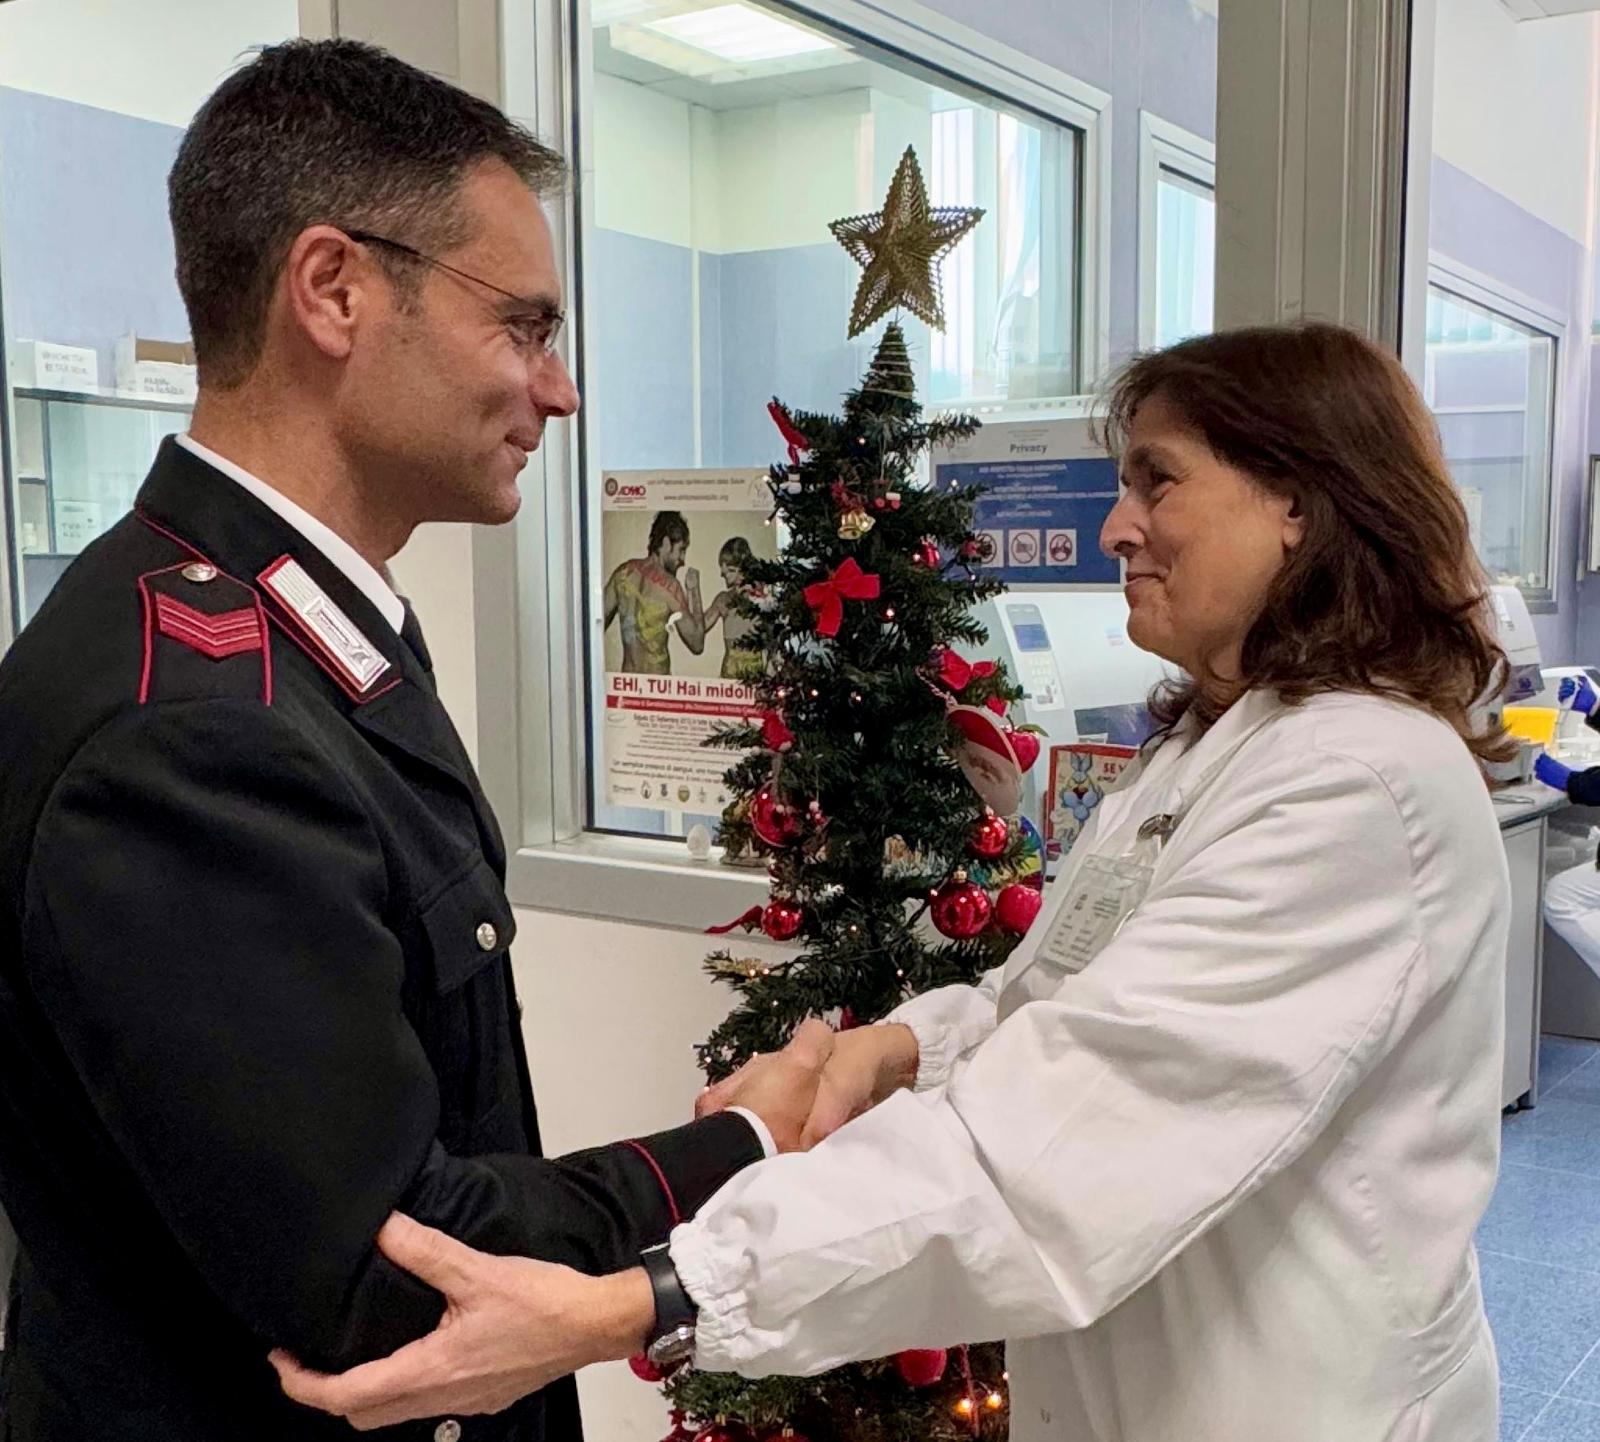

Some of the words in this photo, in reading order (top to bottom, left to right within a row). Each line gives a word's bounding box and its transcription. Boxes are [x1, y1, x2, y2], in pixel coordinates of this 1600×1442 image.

[1010, 443, 1048, 454] Privacy
[613, 676, 642, 694] EHI,
[648, 679, 671, 694] TU!
[677, 681, 701, 696] Hai
